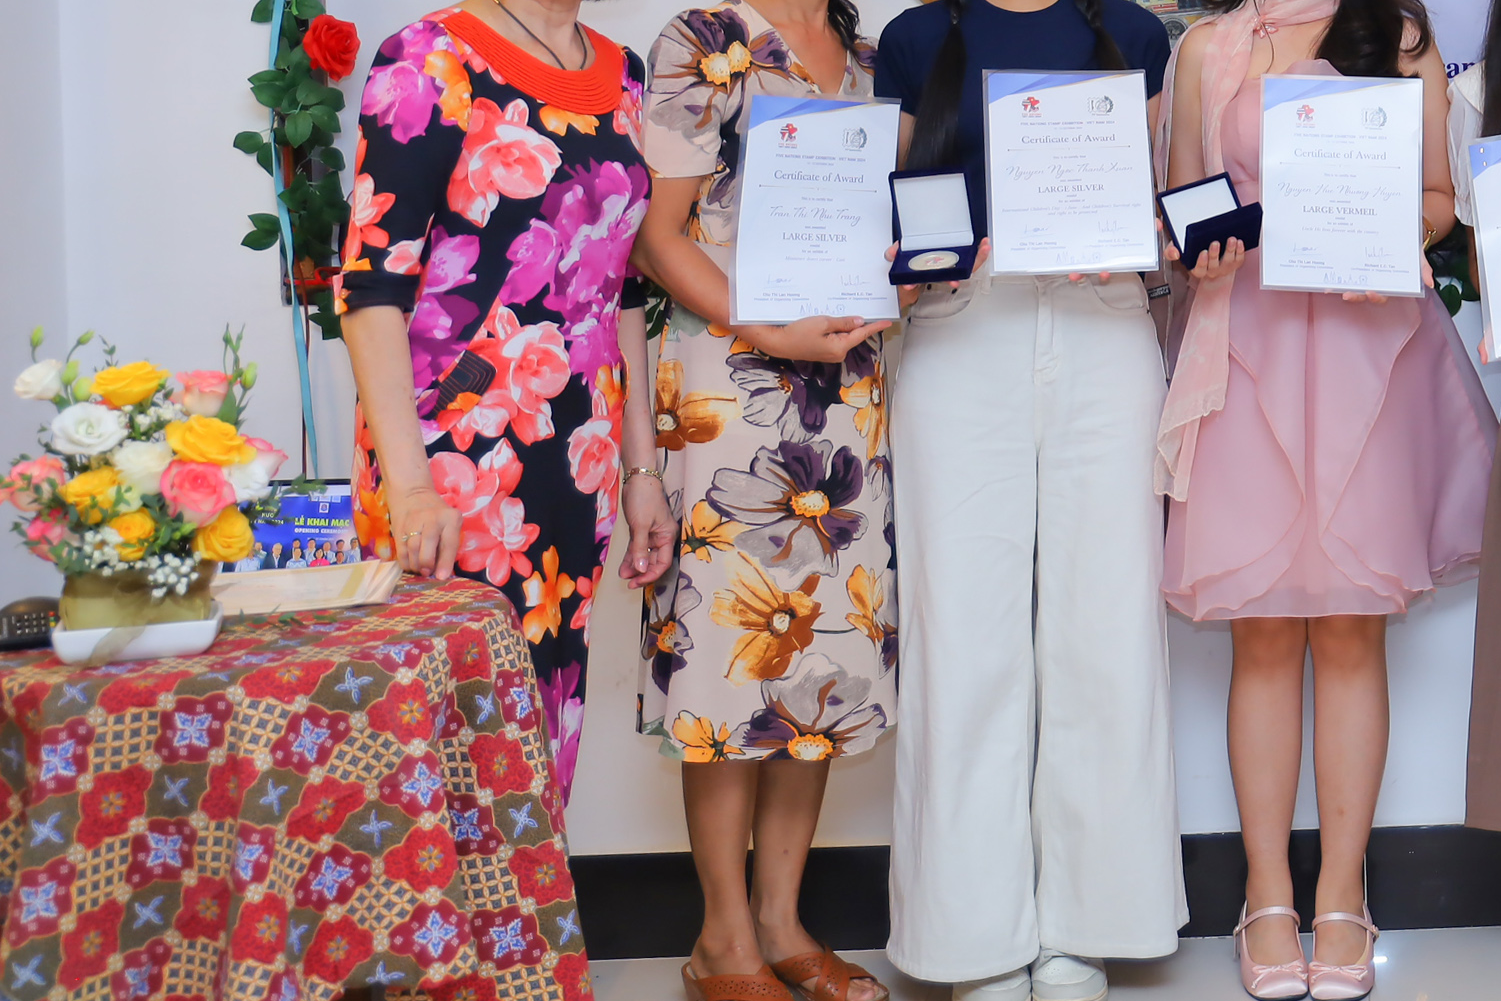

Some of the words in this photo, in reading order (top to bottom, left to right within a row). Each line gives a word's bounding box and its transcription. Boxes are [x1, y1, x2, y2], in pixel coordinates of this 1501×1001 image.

[1021, 136, 1069, 144] Certificate
[1084, 134, 1116, 142] Award
[1294, 148, 1340, 158] Certificate
[1344, 150, 1354, 159] of
[1356, 151, 1386, 160] Award
[774, 170, 820, 182] Certificate
[822, 172, 832, 182] of
[834, 173, 864, 183] Award
[1303, 205, 1334, 214] LARGE
[1336, 207, 1377, 216] VERMEIL
[782, 232, 813, 241] LARGE
[815, 234, 847, 242] SILVER
[307, 518, 328, 526] KHAI
[331, 519, 350, 528] MẠC
